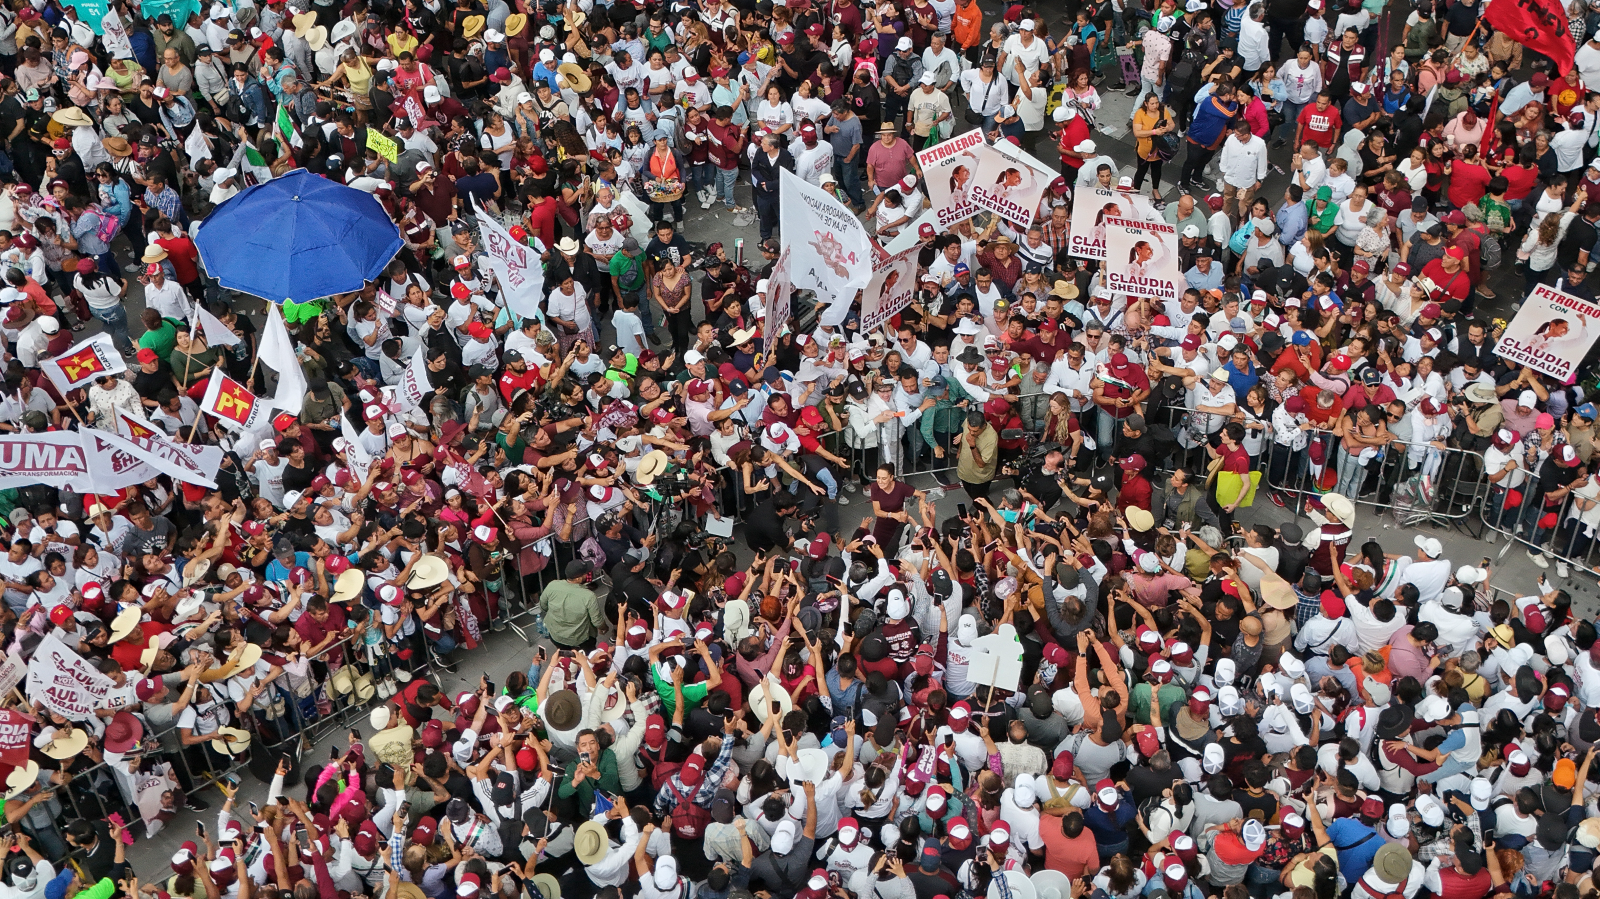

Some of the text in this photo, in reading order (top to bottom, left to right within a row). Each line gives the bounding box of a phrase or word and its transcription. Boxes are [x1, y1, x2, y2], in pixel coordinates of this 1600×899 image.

[920, 131, 983, 166] PETROLEROS
[940, 156, 956, 167] CON
[973, 186, 1031, 218] CLAUDIA
[1095, 188, 1113, 197] CON
[940, 204, 985, 226] SHEIBA
[970, 193, 1030, 225] SHEIBAUM
[1107, 217, 1175, 234] PETROLEROS
[879, 263, 893, 274] CON
[1109, 273, 1175, 290] CLAUDIA
[1110, 283, 1175, 298] SHEIBAUM
[1535, 287, 1600, 320] PETROLERO
[863, 289, 912, 324] CLAUDIA
[863, 296, 913, 332] SHEIBAUM
[1549, 304, 1568, 314] CON
[1498, 346, 1568, 378] SHEIBAUM
[1503, 338, 1571, 370] CLAUDIA
[65, 357, 95, 381] PT
[406, 361, 422, 401] oren
[217, 391, 250, 419] PT
[0, 443, 85, 469] UMA
[0, 723, 29, 736] DIA
